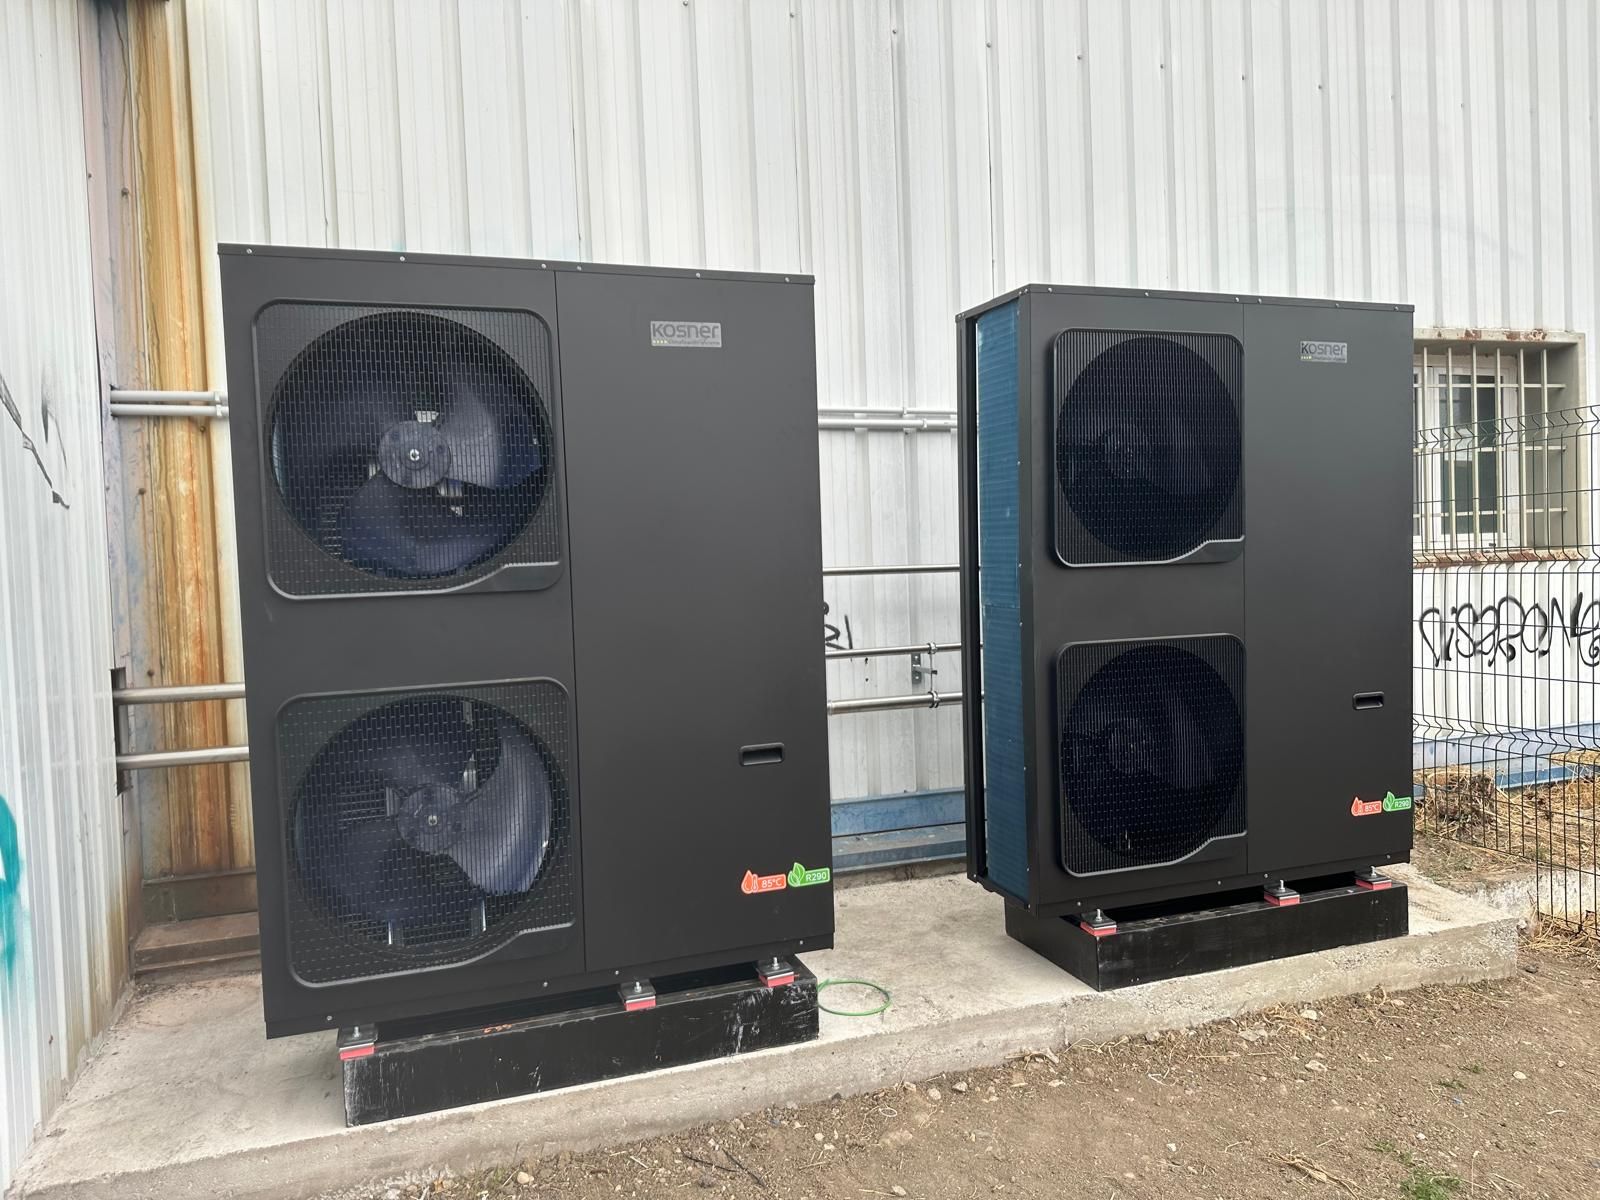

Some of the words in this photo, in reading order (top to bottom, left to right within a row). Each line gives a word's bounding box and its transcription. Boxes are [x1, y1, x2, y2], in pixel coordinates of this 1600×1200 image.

[1394, 800, 1410, 808] R290
[806, 872, 827, 882] R290
[761, 878, 782, 888] 85°C
